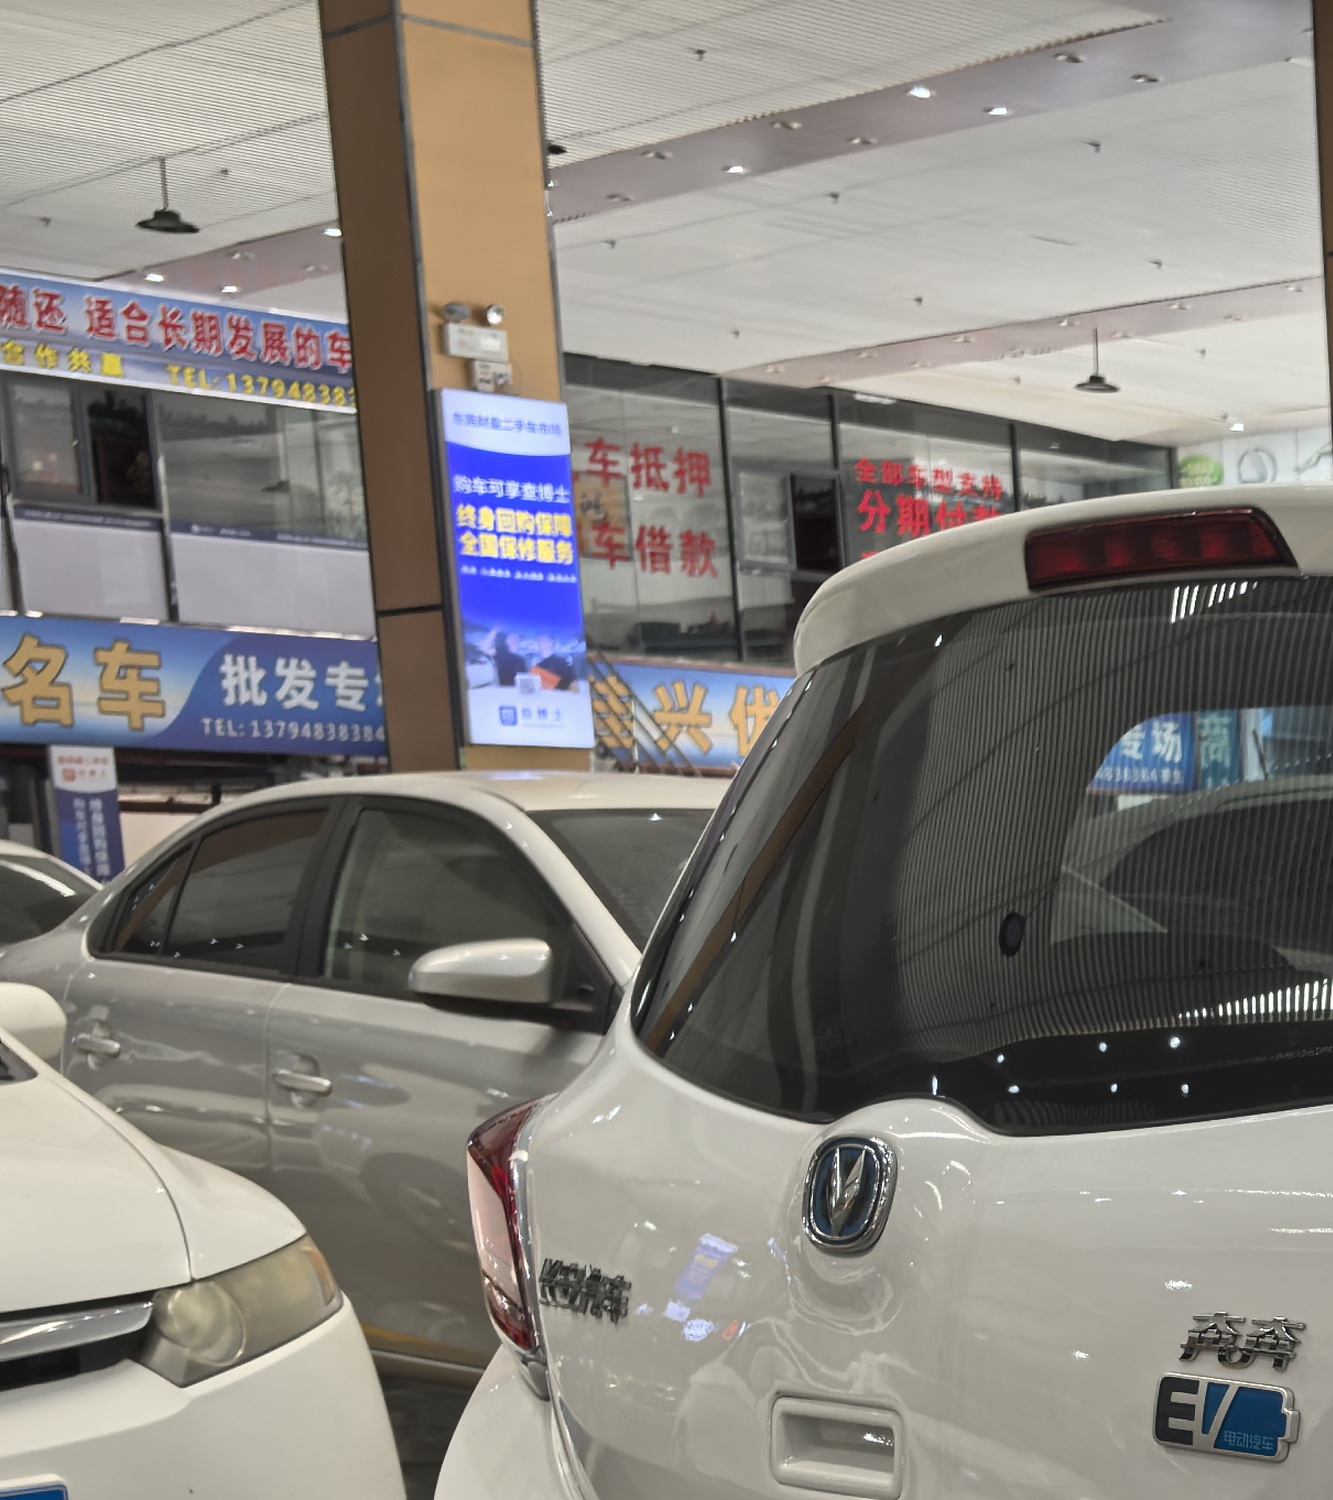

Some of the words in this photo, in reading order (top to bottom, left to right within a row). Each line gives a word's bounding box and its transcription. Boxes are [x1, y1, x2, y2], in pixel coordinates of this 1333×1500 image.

[572, 437, 712, 498] 车抵押
[855, 457, 1004, 502] 全部车型支持
[578, 519, 718, 579] 车借款
[2, 633, 167, 732] 名车
[220, 653, 383, 712] 批发专
[1199, 710, 1233, 789] 商
[1155, 1376, 1241, 1449] EV
[1223, 1430, 1275, 1451] 电动汽车
